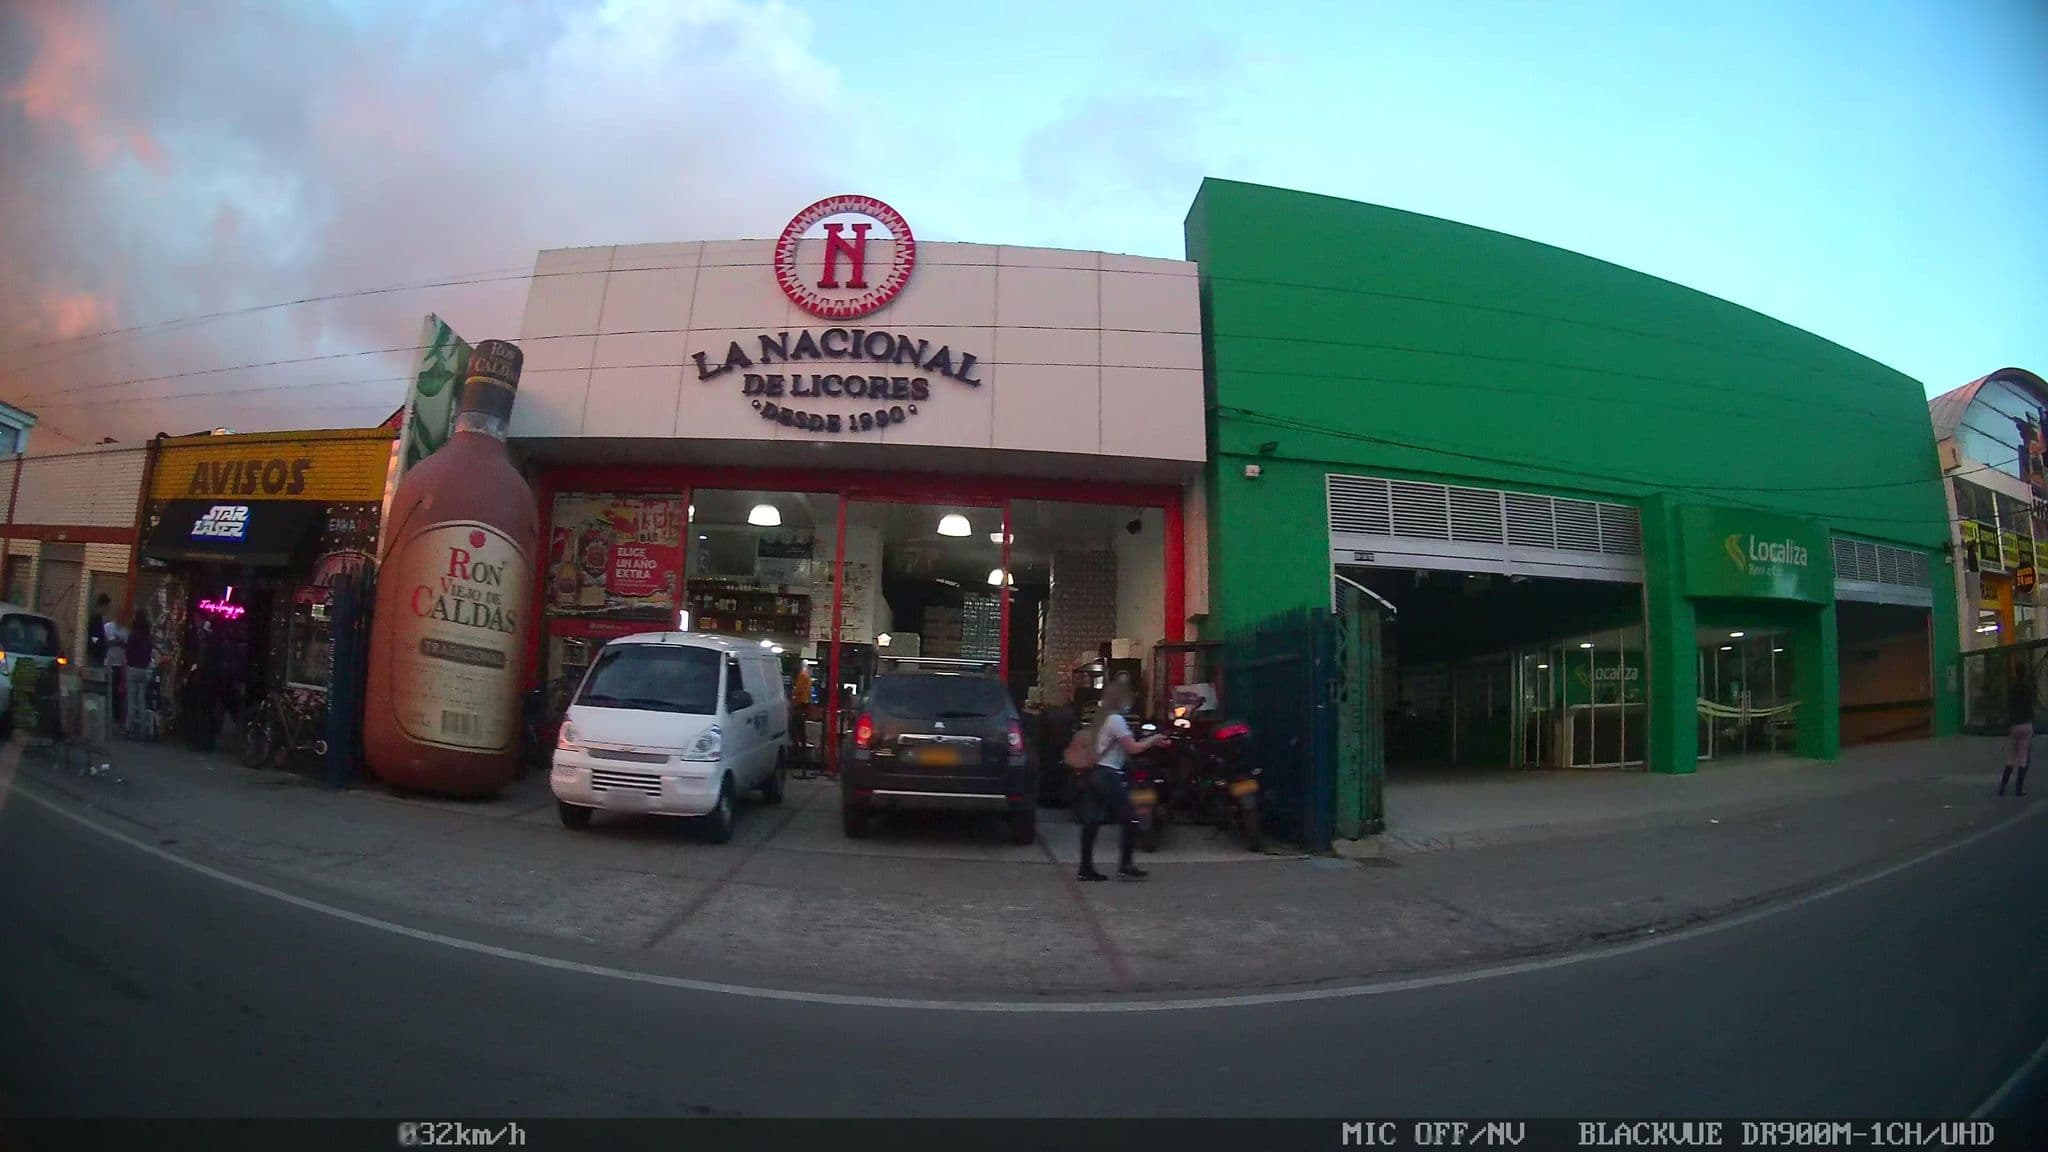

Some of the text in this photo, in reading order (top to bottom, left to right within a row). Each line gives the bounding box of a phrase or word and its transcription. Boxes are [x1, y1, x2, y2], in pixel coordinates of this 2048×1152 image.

[691, 327, 982, 388] LA NACIONAL
[742, 374, 930, 400] DE LICORES
[760, 401, 905, 433] DESDE 1990
[188, 458, 313, 496] AVISOS
[191, 520, 245, 538] LASER
[202, 505, 249, 522] STAR
[447, 546, 505, 586] RON
[1750, 534, 1808, 566] Localiza
[615, 568, 651, 579] EXTRA
[411, 584, 517, 632] CALDAS
